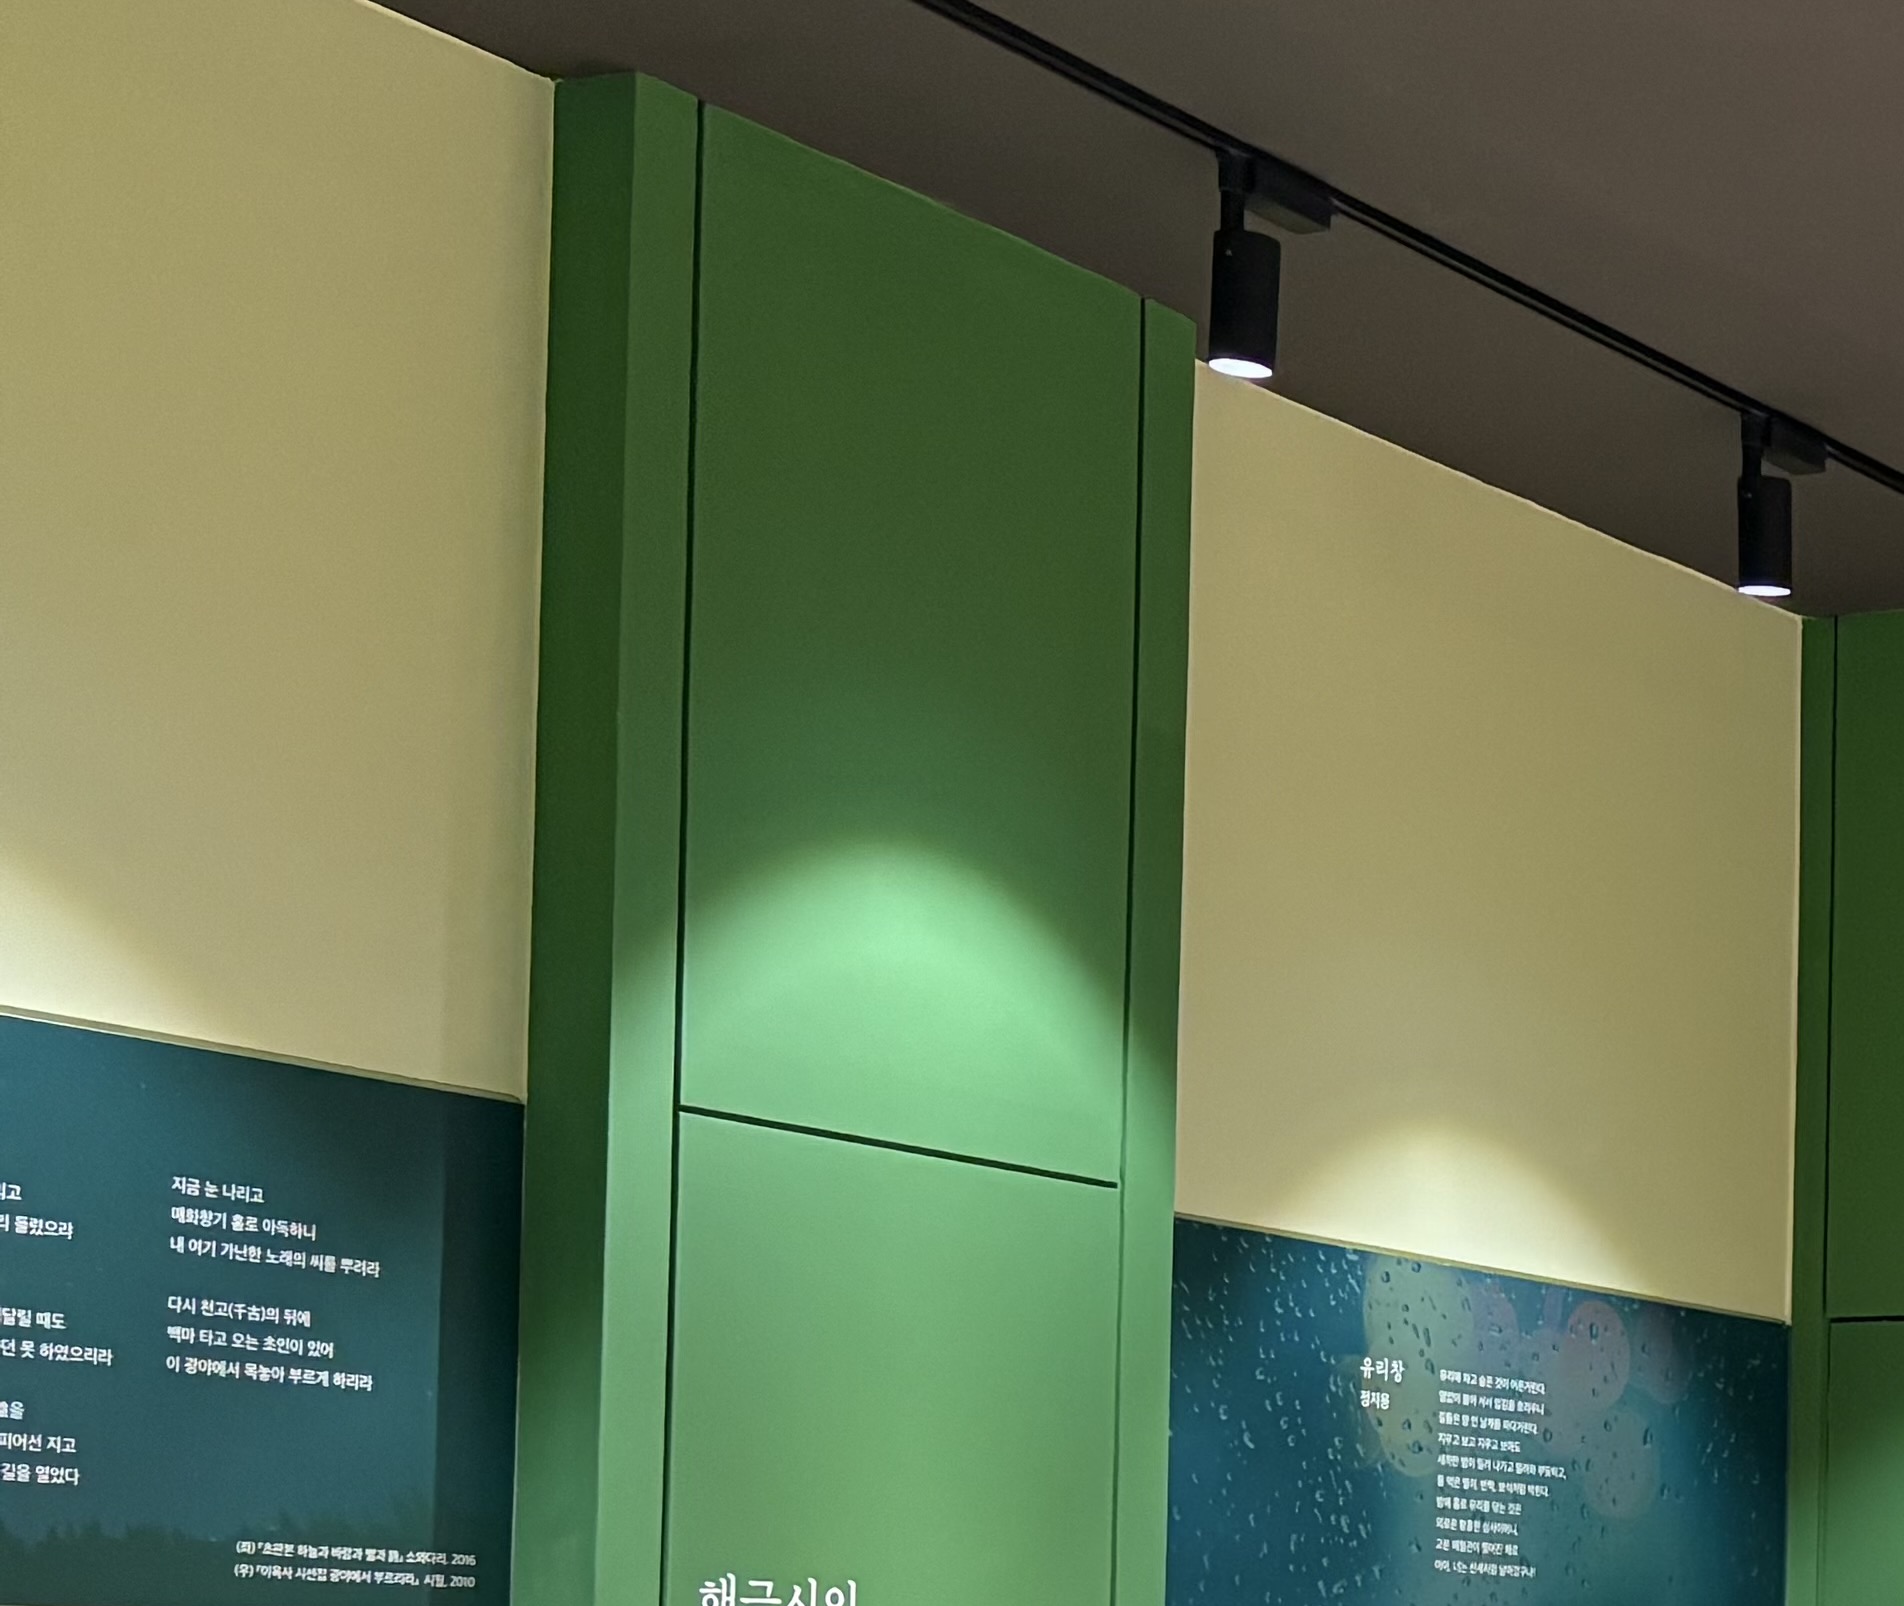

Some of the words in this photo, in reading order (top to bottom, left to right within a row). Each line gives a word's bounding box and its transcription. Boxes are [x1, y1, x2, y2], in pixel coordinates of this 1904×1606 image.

[171, 1176, 201, 1196] 지금
[204, 1180, 219, 1198] 눈
[222, 1184, 264, 1202] 나리고
[231, 1214, 258, 1231] 홀로
[262, 1219, 316, 1240] 아득하니
[170, 1236, 184, 1253] 내
[188, 1238, 216, 1257] 여기
[265, 1249, 306, 1268] 노래의
[309, 1254, 336, 1272] 씨를
[167, 1296, 196, 1314] 다시
[283, 1309, 310, 1327] 뒤에
[19, 1340, 35, 1358] 못
[39, 1343, 113, 1365] 하였으리라
[166, 1326, 195, 1343] 백마
[199, 1329, 227, 1346] 타고
[231, 1332, 259, 1350] 오는
[262, 1335, 303, 1355] 초인이
[307, 1340, 334, 1358] 있어
[166, 1355, 180, 1372] 이
[184, 1357, 240, 1378] 광야에서
[244, 1362, 285, 1382] 목놓아
[288, 1368, 329, 1387] 부르게
[332, 1372, 373, 1391] 하리라
[1359, 1357, 1405, 1382] 유리창
[0, 1463, 31, 1482] 길을
[35, 1465, 80, 1485] 열었다
